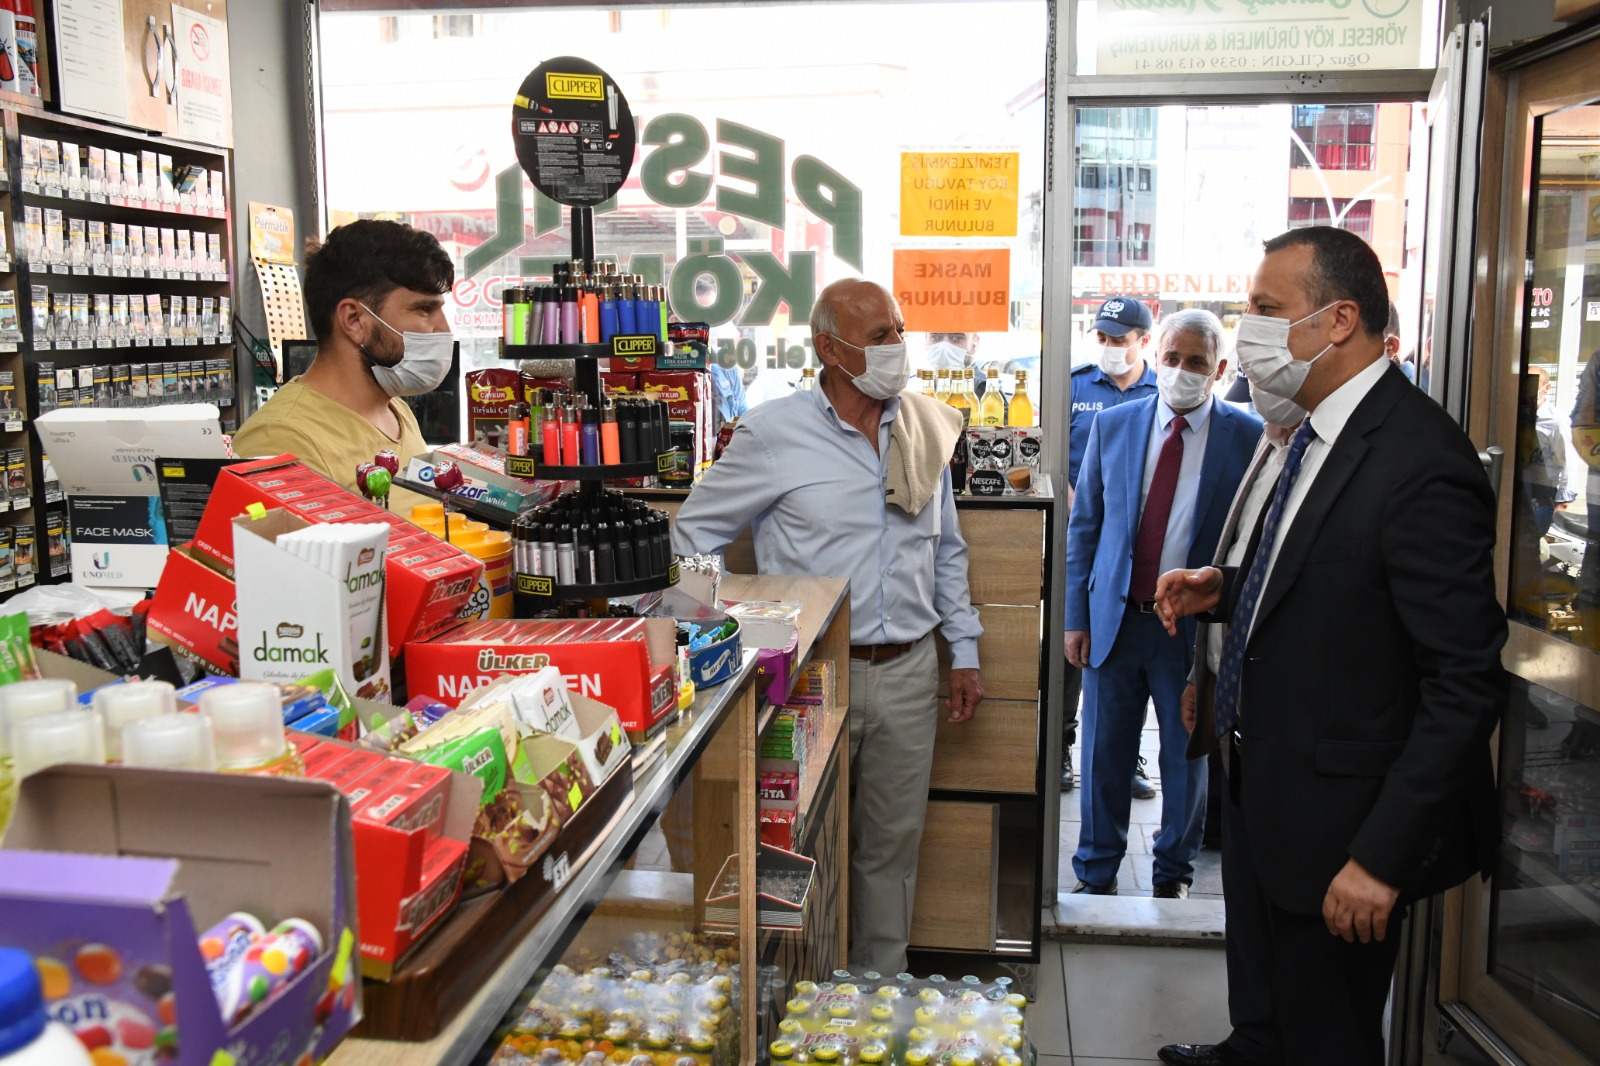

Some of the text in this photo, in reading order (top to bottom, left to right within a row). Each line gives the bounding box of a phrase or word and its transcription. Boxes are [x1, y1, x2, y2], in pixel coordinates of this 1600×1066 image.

[553, 79, 597, 94] CLIPPER
[254, 215, 289, 233] Permatik
[618, 340, 652, 351] CLIPPER
[658, 391, 679, 399] AYKUR
[472, 406, 497, 416] Tiryaki
[486, 495, 508, 507] White
[76, 527, 154, 538] FACE MASK
[82, 570, 124, 579] UNOMED
[519, 578, 550, 592] CLIPPER
[184, 592, 239, 634] NAP
[253, 630, 329, 663] damak
[478, 649, 550, 671] ÜLKER
[463, 747, 494, 773] ÜLKER
[803, 1031, 859, 1046] Fresa
